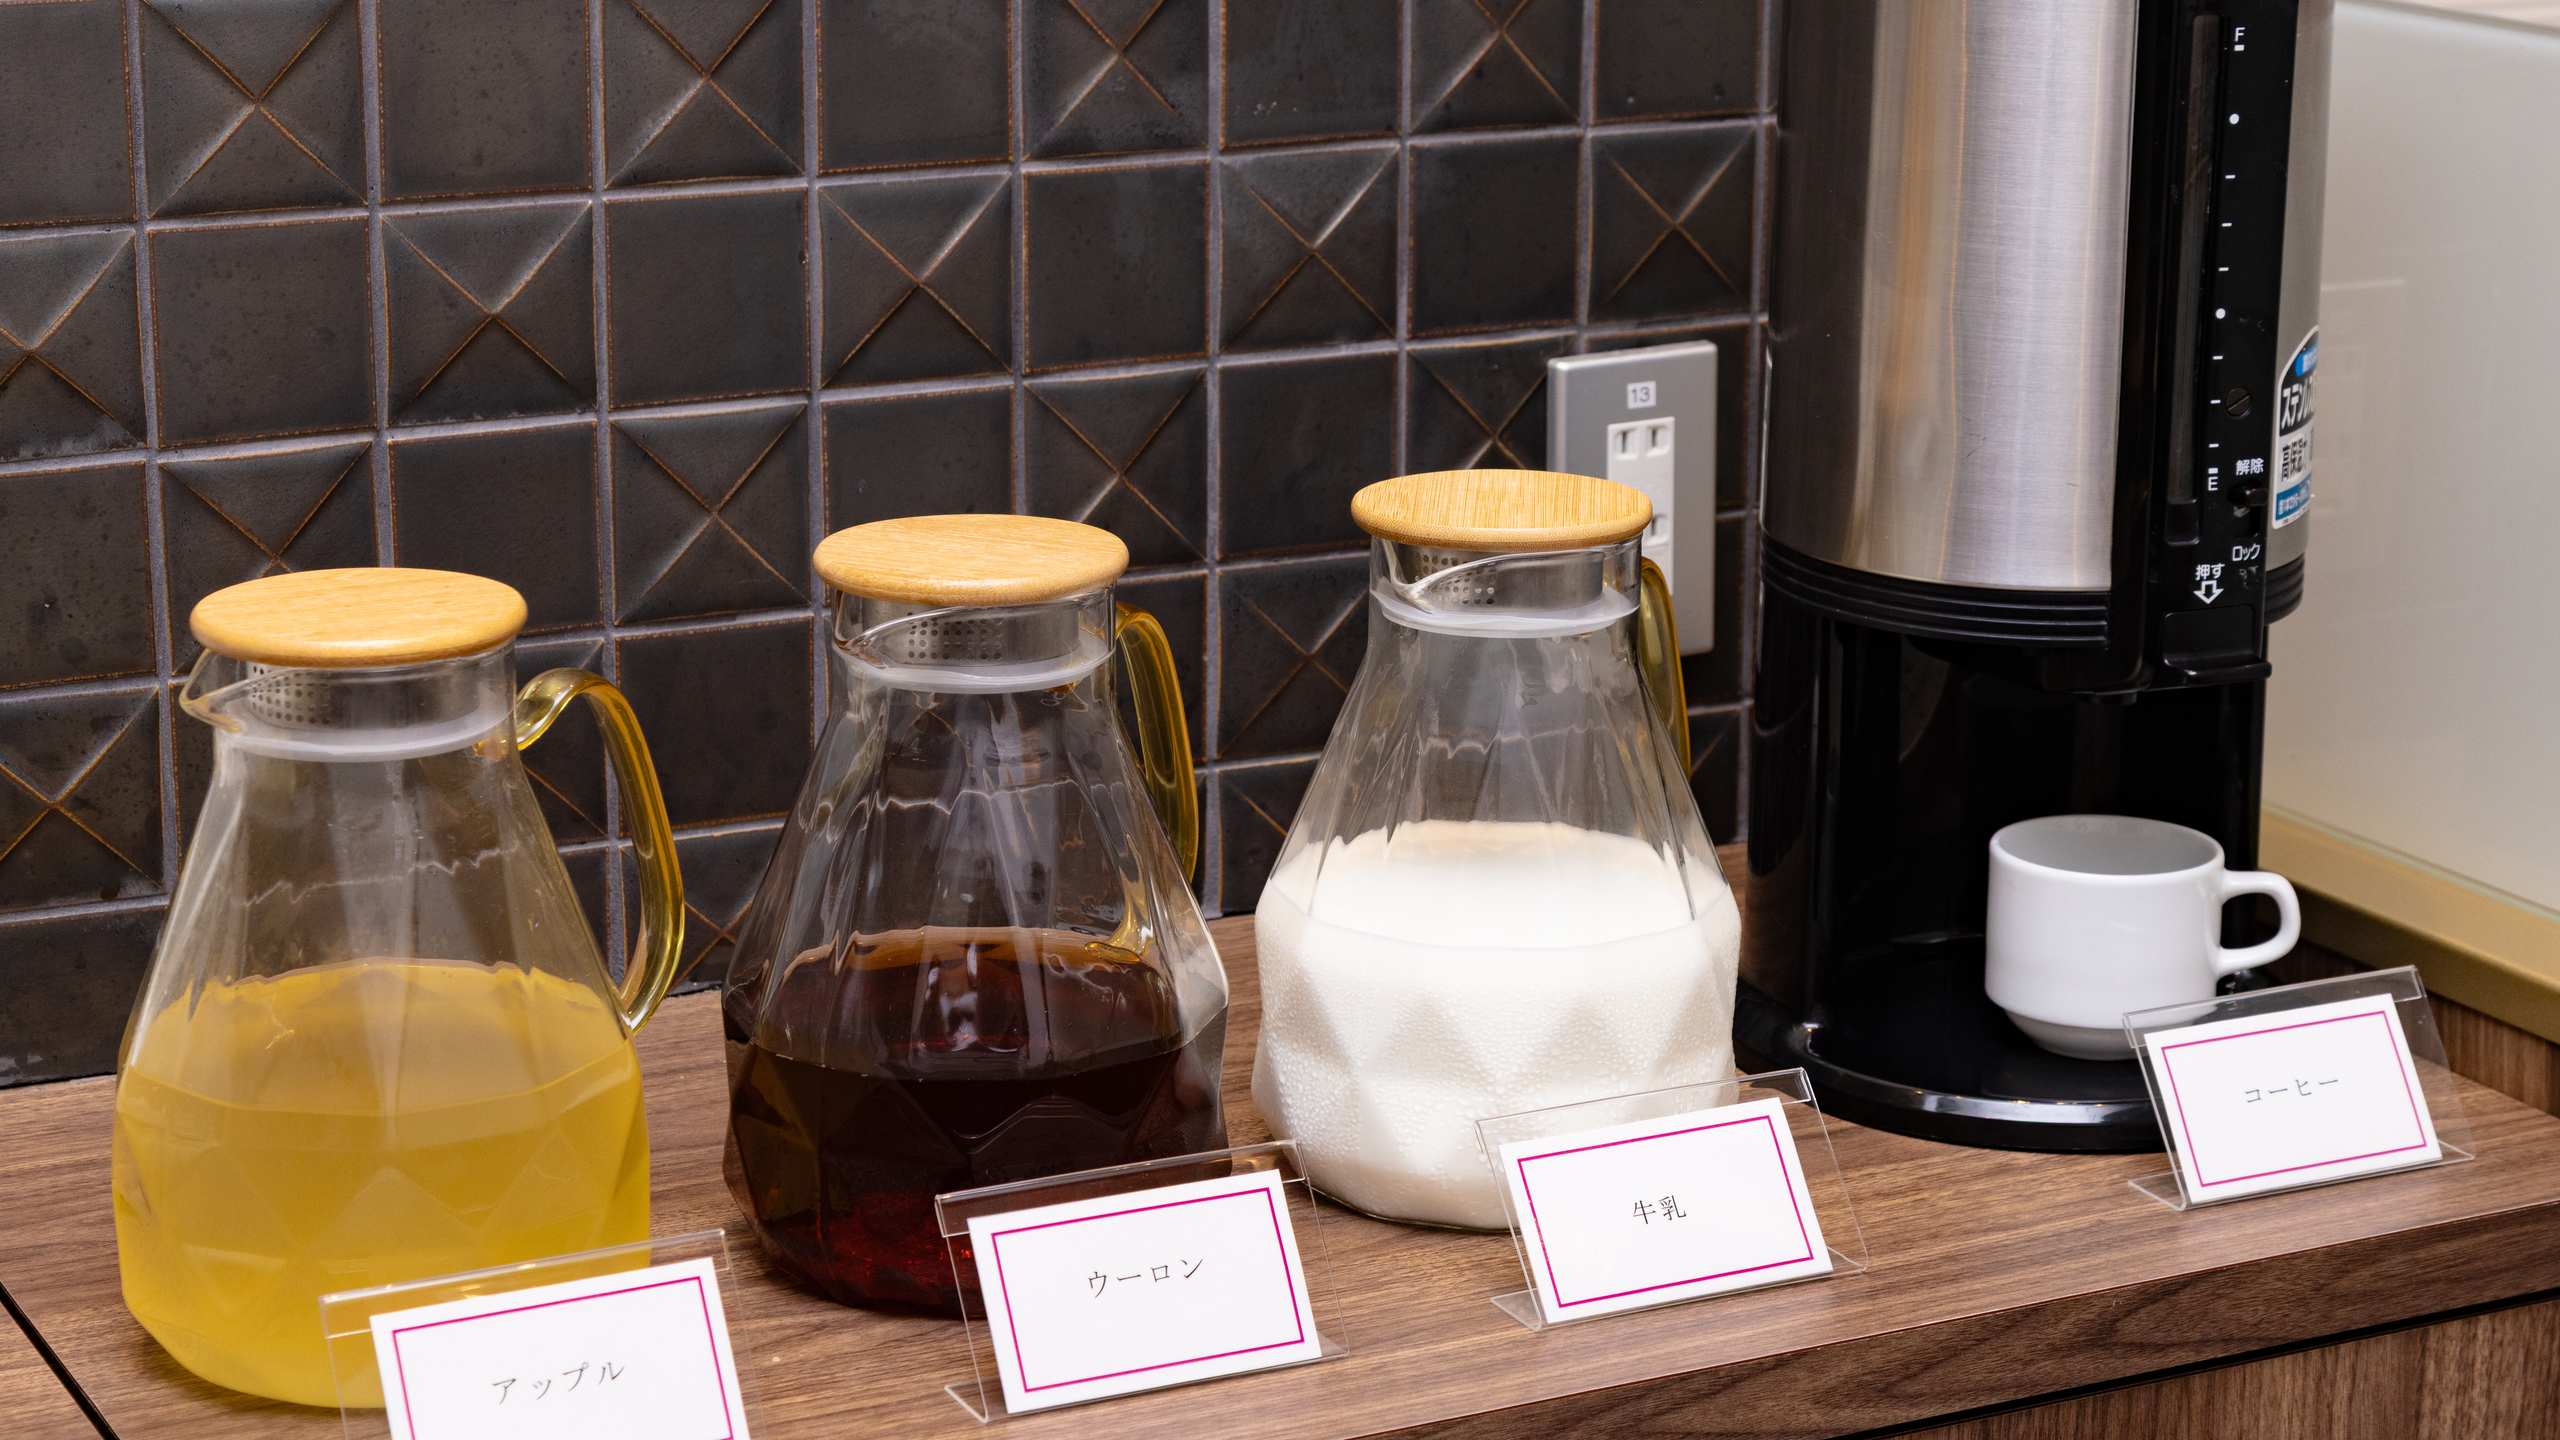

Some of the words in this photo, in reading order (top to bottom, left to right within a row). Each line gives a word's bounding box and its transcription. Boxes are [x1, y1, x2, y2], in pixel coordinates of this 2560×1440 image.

[2234, 26, 2246, 42] F
[1631, 386, 1650, 404] 13
[2235, 457, 2264, 476] 解除
[2207, 476, 2219, 492] E
[2232, 543, 2261, 562] ロック
[2195, 562, 2226, 581] 押す
[2244, 1076, 2340, 1104] コーヒー
[1632, 1194, 1688, 1228] 牛乳
[1086, 1258, 1205, 1300] ウーロン
[492, 1359, 626, 1406] アップル
